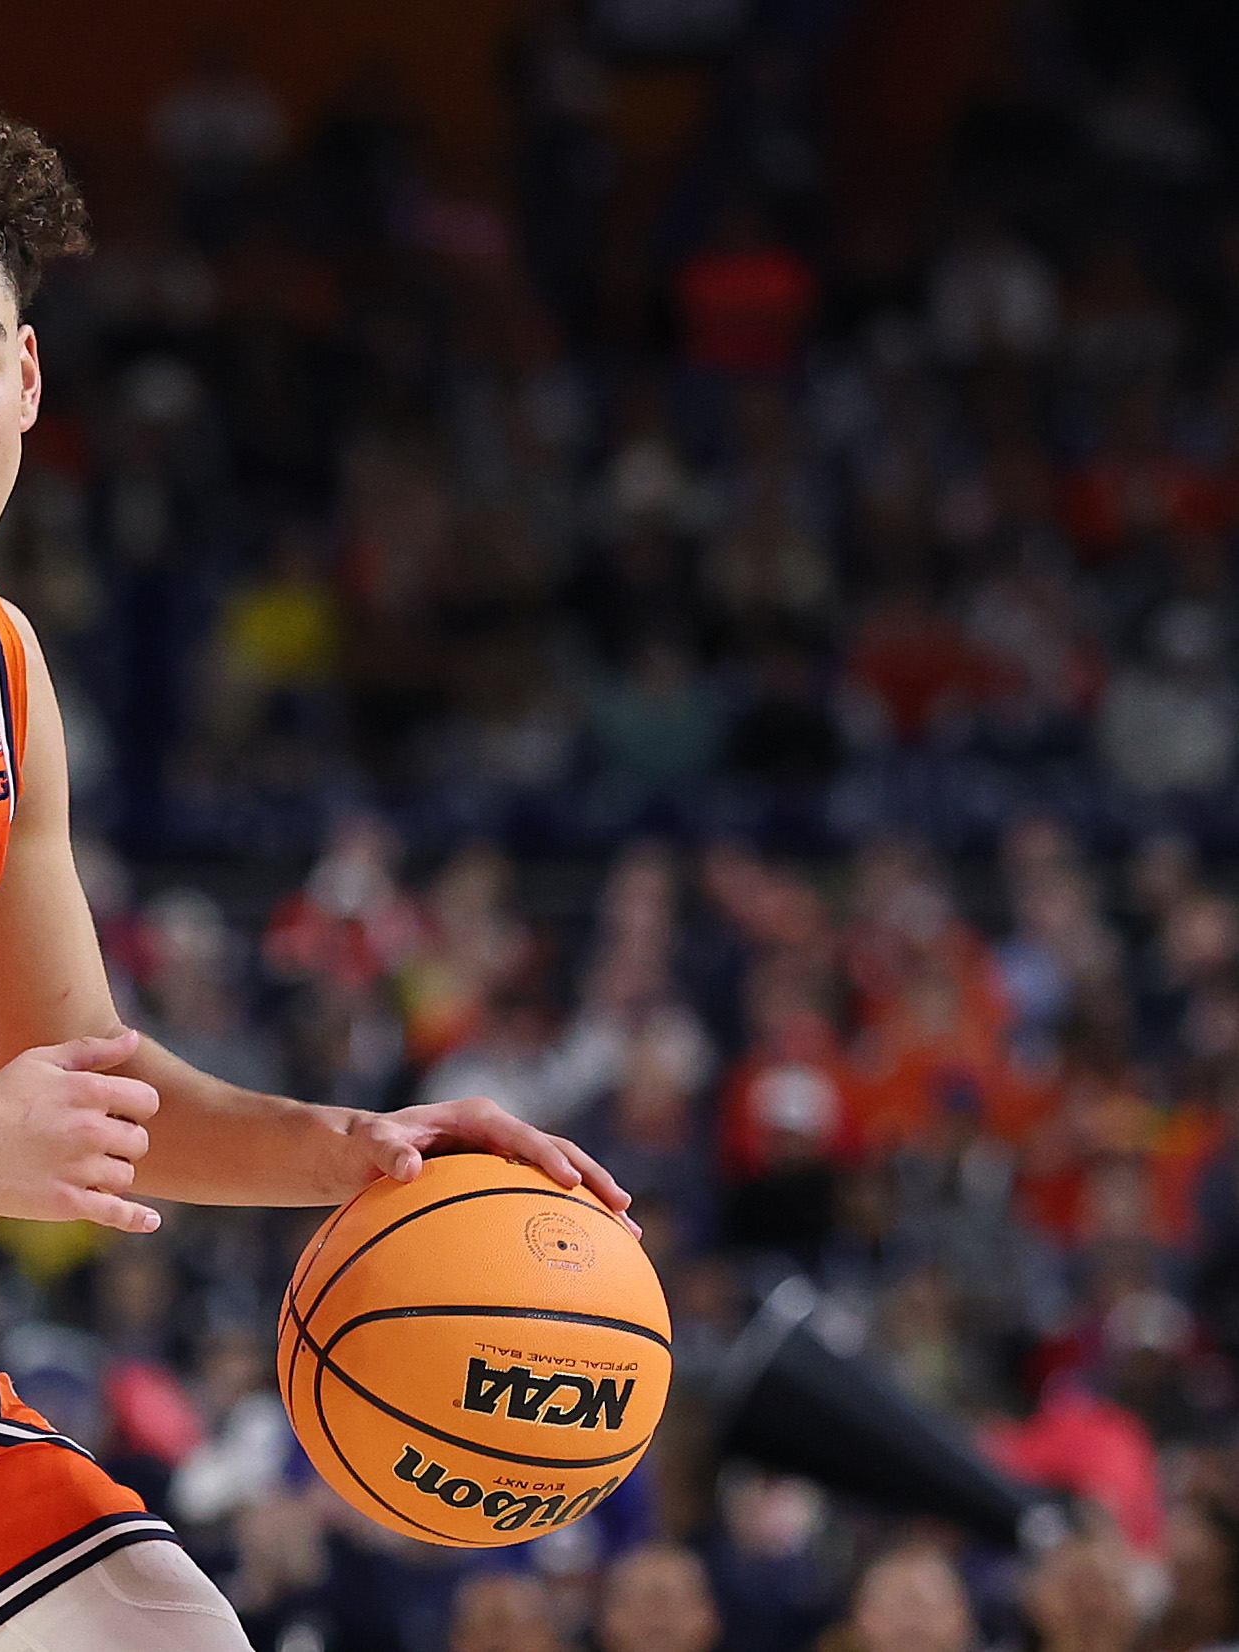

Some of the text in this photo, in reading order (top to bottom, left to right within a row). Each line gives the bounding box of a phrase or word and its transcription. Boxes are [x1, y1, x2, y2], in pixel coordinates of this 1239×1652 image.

[474, 1342, 639, 1371] OFFICIAL GAME BALL
[463, 1357, 636, 1431] NCAA
[392, 1442, 620, 1531] Wilson
[492, 1476, 566, 1491] EVO NXT
